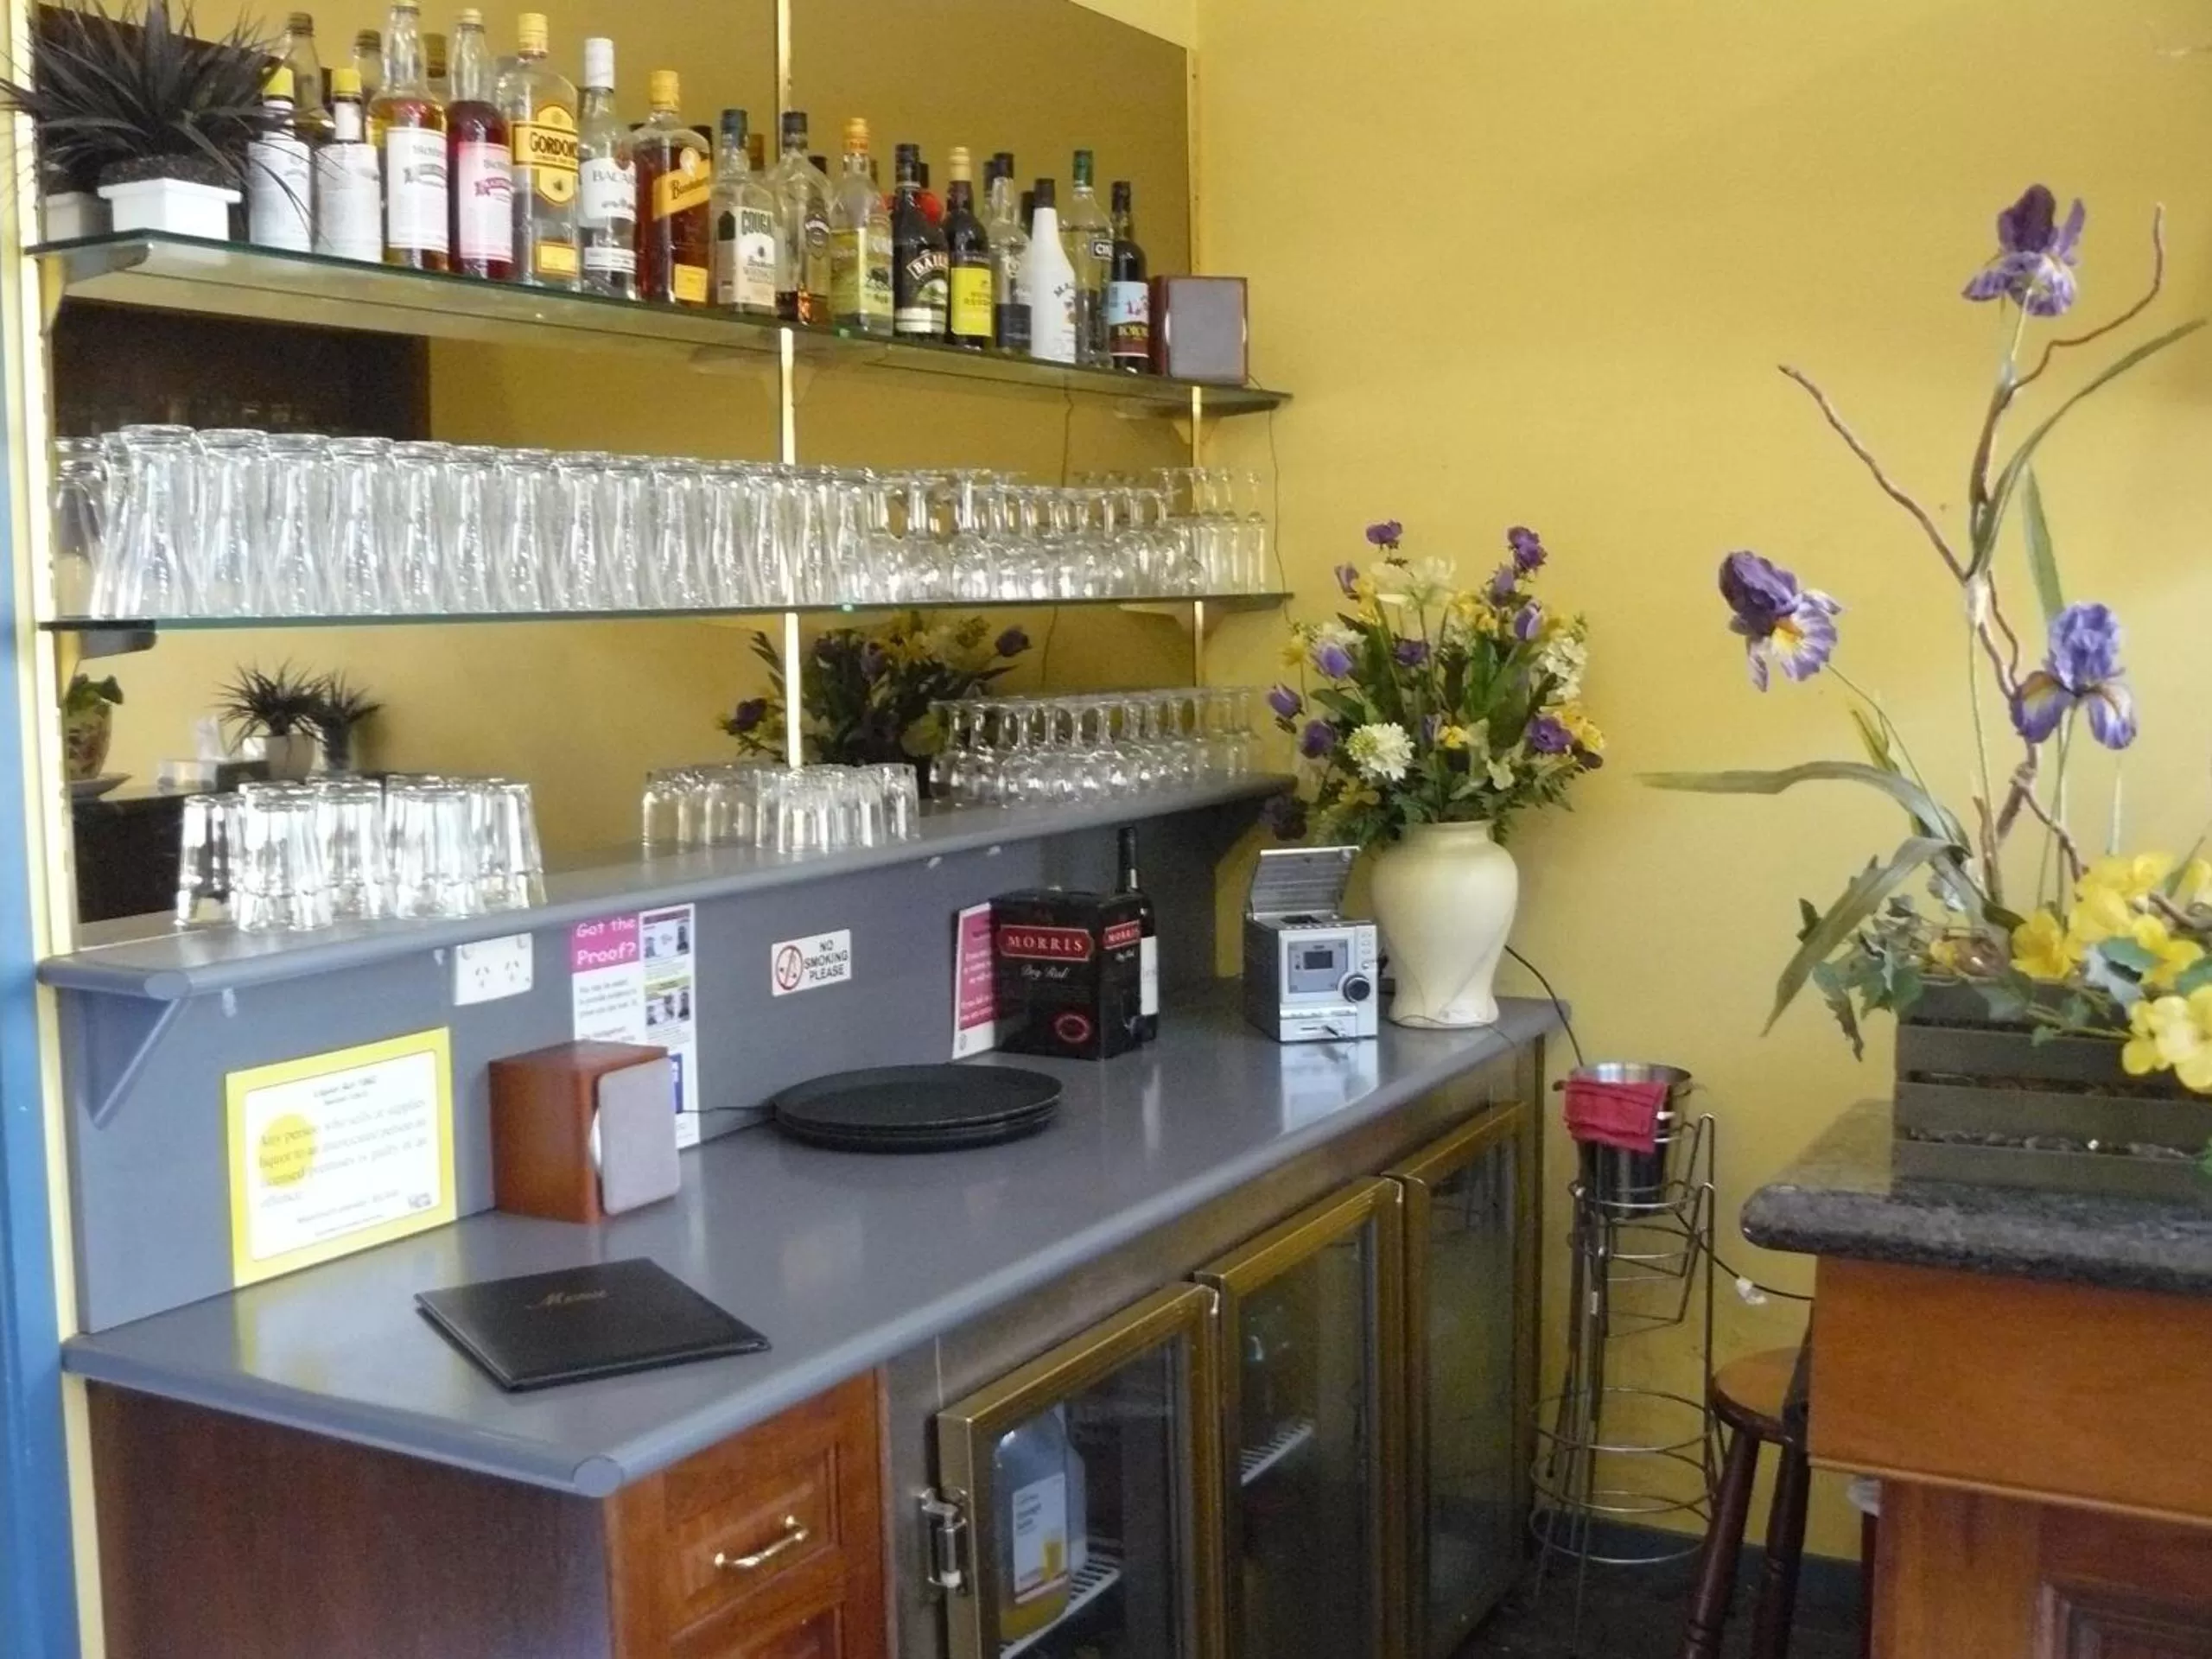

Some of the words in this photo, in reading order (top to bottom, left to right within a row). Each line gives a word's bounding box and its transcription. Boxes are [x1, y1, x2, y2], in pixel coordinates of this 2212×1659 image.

[575, 920, 605, 938] Got
[610, 917, 636, 931] the
[818, 939, 834, 952] NO
[1006, 935, 1083, 952] MORRIS
[576, 942, 637, 966] Proof?
[804, 950, 848, 969] SMOKING
[809, 963, 844, 980] PLEASE
